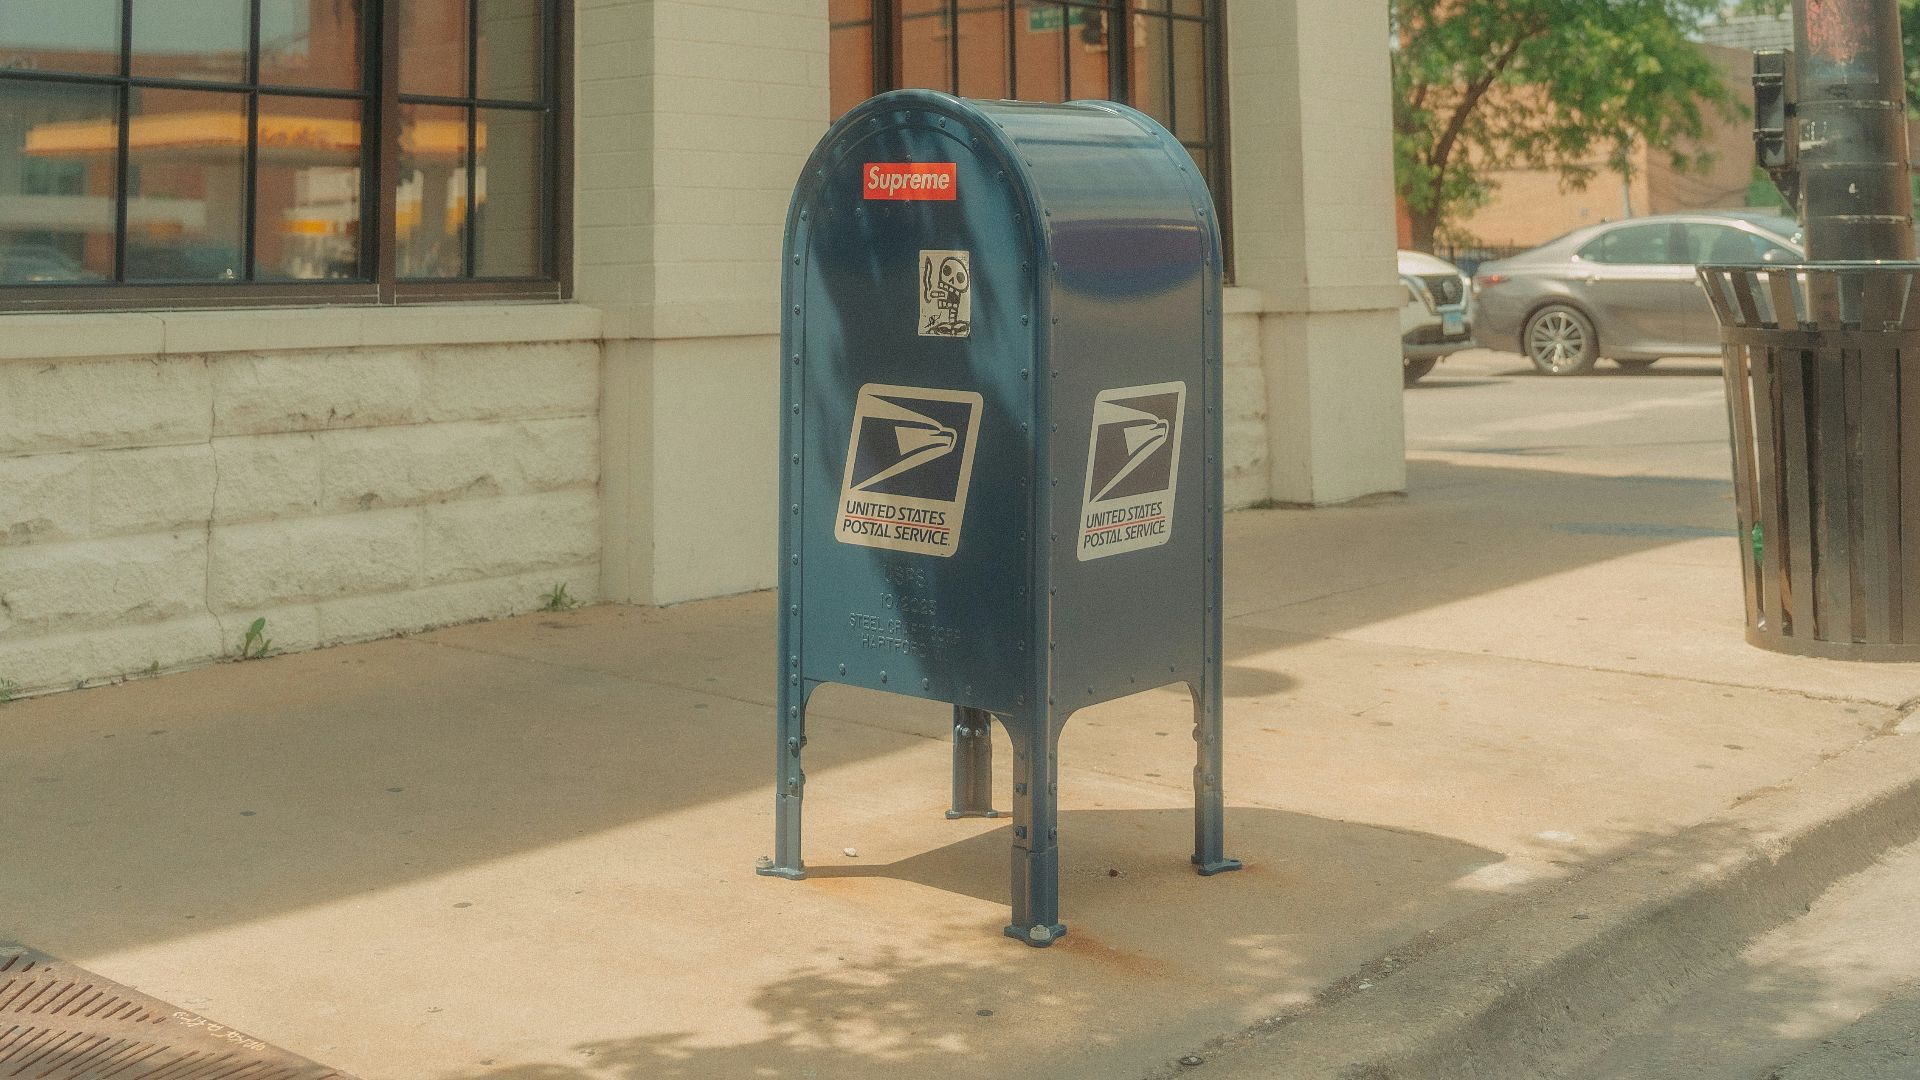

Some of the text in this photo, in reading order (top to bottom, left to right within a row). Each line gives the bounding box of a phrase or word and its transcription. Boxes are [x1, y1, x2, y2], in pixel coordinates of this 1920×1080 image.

[867, 165, 950, 196] Supreme
[846, 500, 946, 526] UNITED STATES
[1086, 502, 1162, 528] UNITED STATES
[843, 519, 891, 538] POSTAL
[1084, 530, 1122, 548] POSTAL
[849, 611, 884, 633] STEEL
